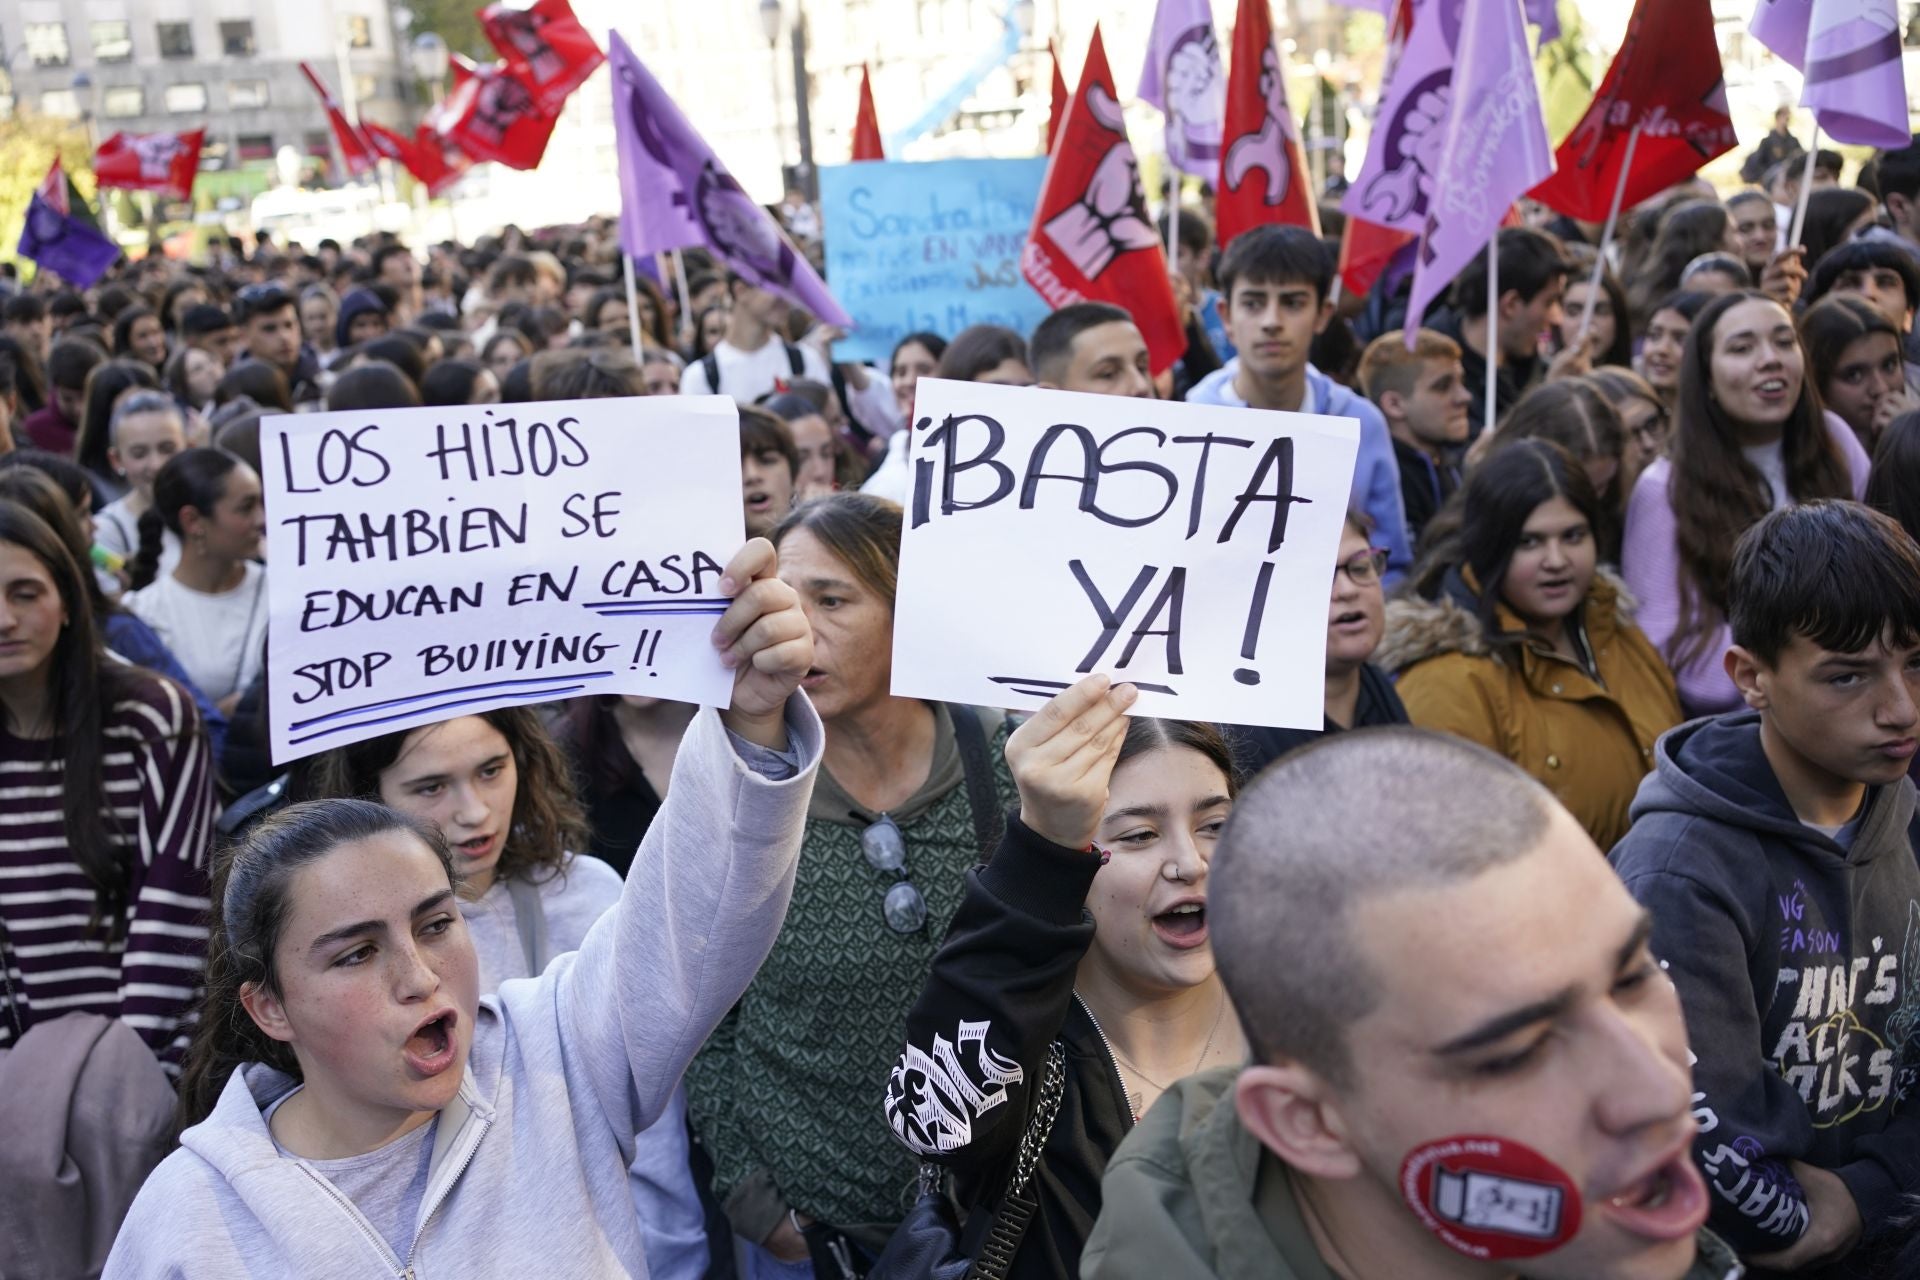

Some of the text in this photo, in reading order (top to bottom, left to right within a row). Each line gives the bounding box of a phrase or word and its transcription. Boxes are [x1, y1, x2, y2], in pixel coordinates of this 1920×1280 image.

[280, 410, 590, 493] LOS HIJOS
[911, 413, 1313, 554] ¡BASTA
[281, 491, 622, 567] TAMBIEN SE
[299, 550, 725, 632] EDUCAN EN CASA
[292, 651, 393, 705] STOP
